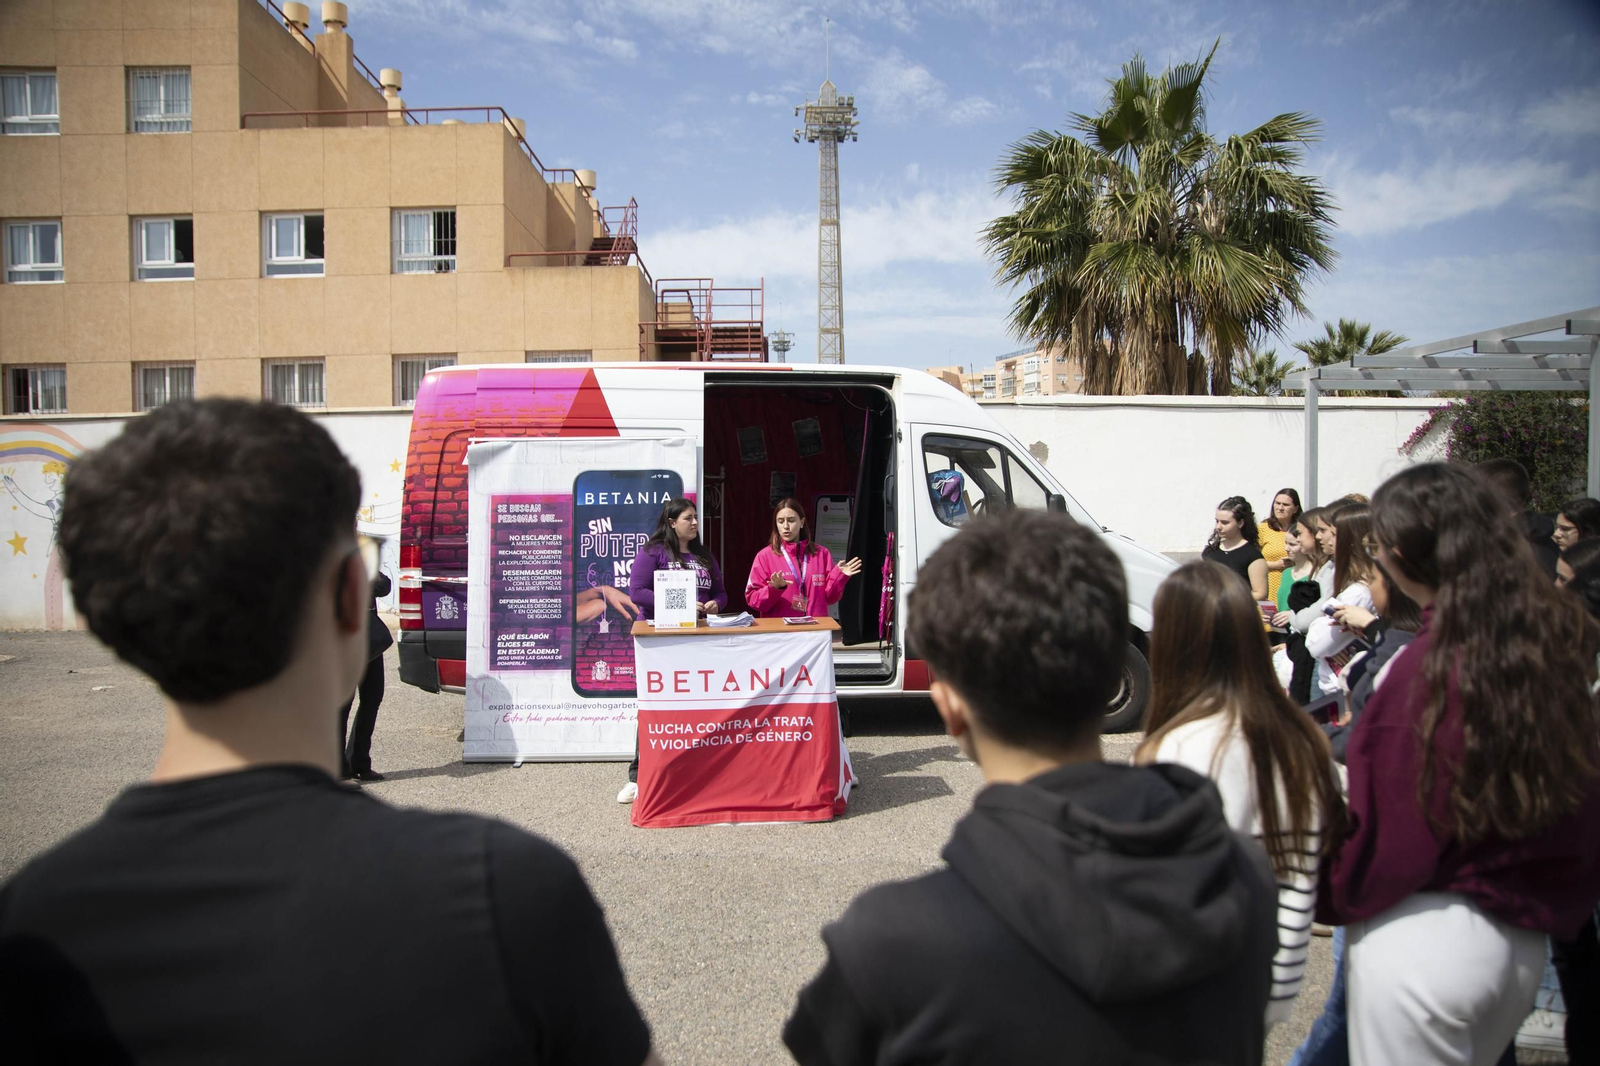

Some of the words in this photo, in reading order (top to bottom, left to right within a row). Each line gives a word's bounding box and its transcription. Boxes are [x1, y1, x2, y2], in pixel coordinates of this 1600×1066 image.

[585, 492, 672, 505] BETANIA
[498, 504, 507, 512] SE
[510, 504, 541, 512] BUSCAN
[498, 514, 538, 523] PERSONAS
[588, 517, 612, 535] SIN
[497, 633, 516, 641] ¿QUÉ
[647, 665, 813, 693] BETANIA
[503, 713, 523, 723] Entre
[525, 713, 542, 723] todos
[544, 714, 577, 726] podemos
[580, 715, 609, 726] romper
[612, 712, 628, 723] esta
[648, 723, 693, 734] LUCHA
[696, 719, 751, 733] CONTRA
[754, 718, 770, 728] LA
[773, 716, 813, 727] TRATA
[650, 739, 658, 750] Y
[659, 736, 733, 751] VIOLENCIA
[736, 733, 753, 744] DE
[756, 728, 813, 742] GÉNERO
